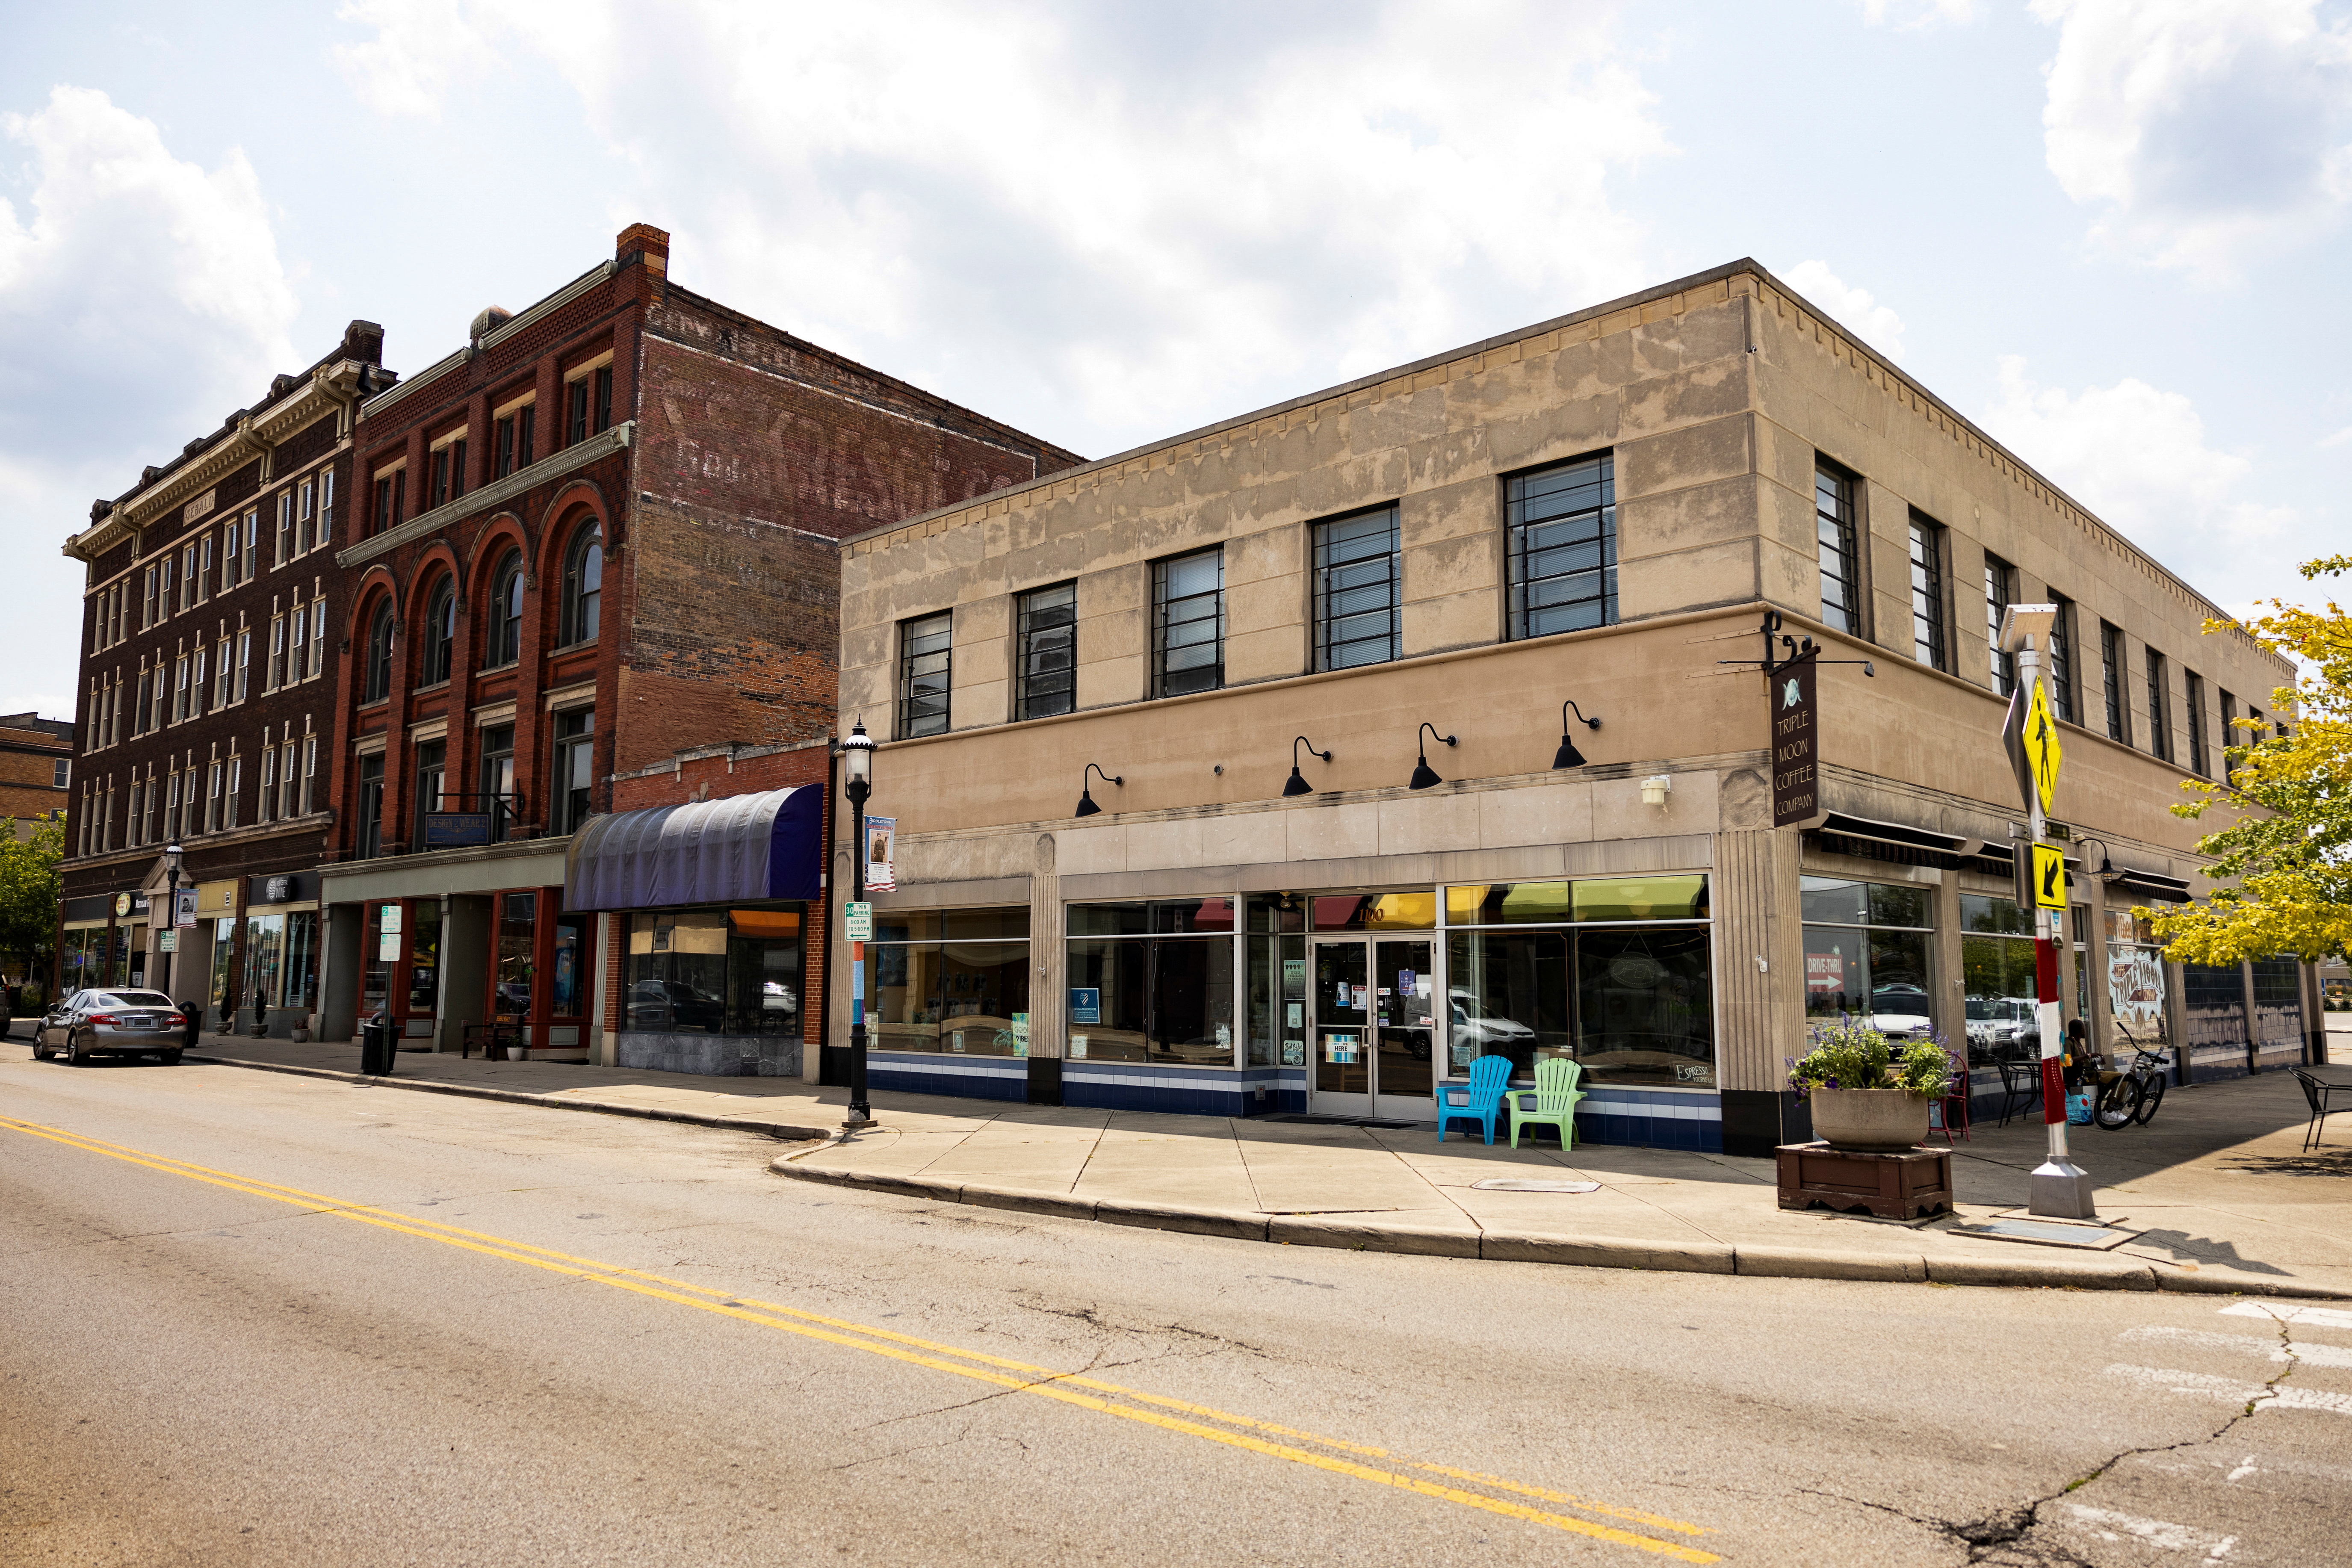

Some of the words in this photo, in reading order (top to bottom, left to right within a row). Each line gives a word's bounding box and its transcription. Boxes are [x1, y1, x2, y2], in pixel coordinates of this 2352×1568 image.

[186, 495, 213, 520] SEBALD
[1777, 710, 1809, 736] TRIPLE
[1779, 738, 1808, 763] MOON
[1776, 765, 1813, 791] COFFEE
[1777, 792, 1813, 815] COMPANY
[429, 818, 452, 827] DESIGN
[455, 819, 458, 828] 2
[460, 817, 480, 828] WEAR
[482, 819, 485, 827] 2
[1358, 908, 1384, 921] 1100
[2116, 914, 2132, 939] Vibes
[1613, 961, 1657, 981] OPEN
[1808, 958, 1841, 973] DRIVE-THRU
[2114, 964, 2125, 977] COFFEE
[2110, 963, 2138, 1004] TRIPLE
[2138, 961, 2163, 995] MOON
[2143, 989, 2156, 1001] COMPANY
[1292, 1043, 1302, 1052] Coffee
[1676, 1065, 1708, 1080] ESPRESSO
